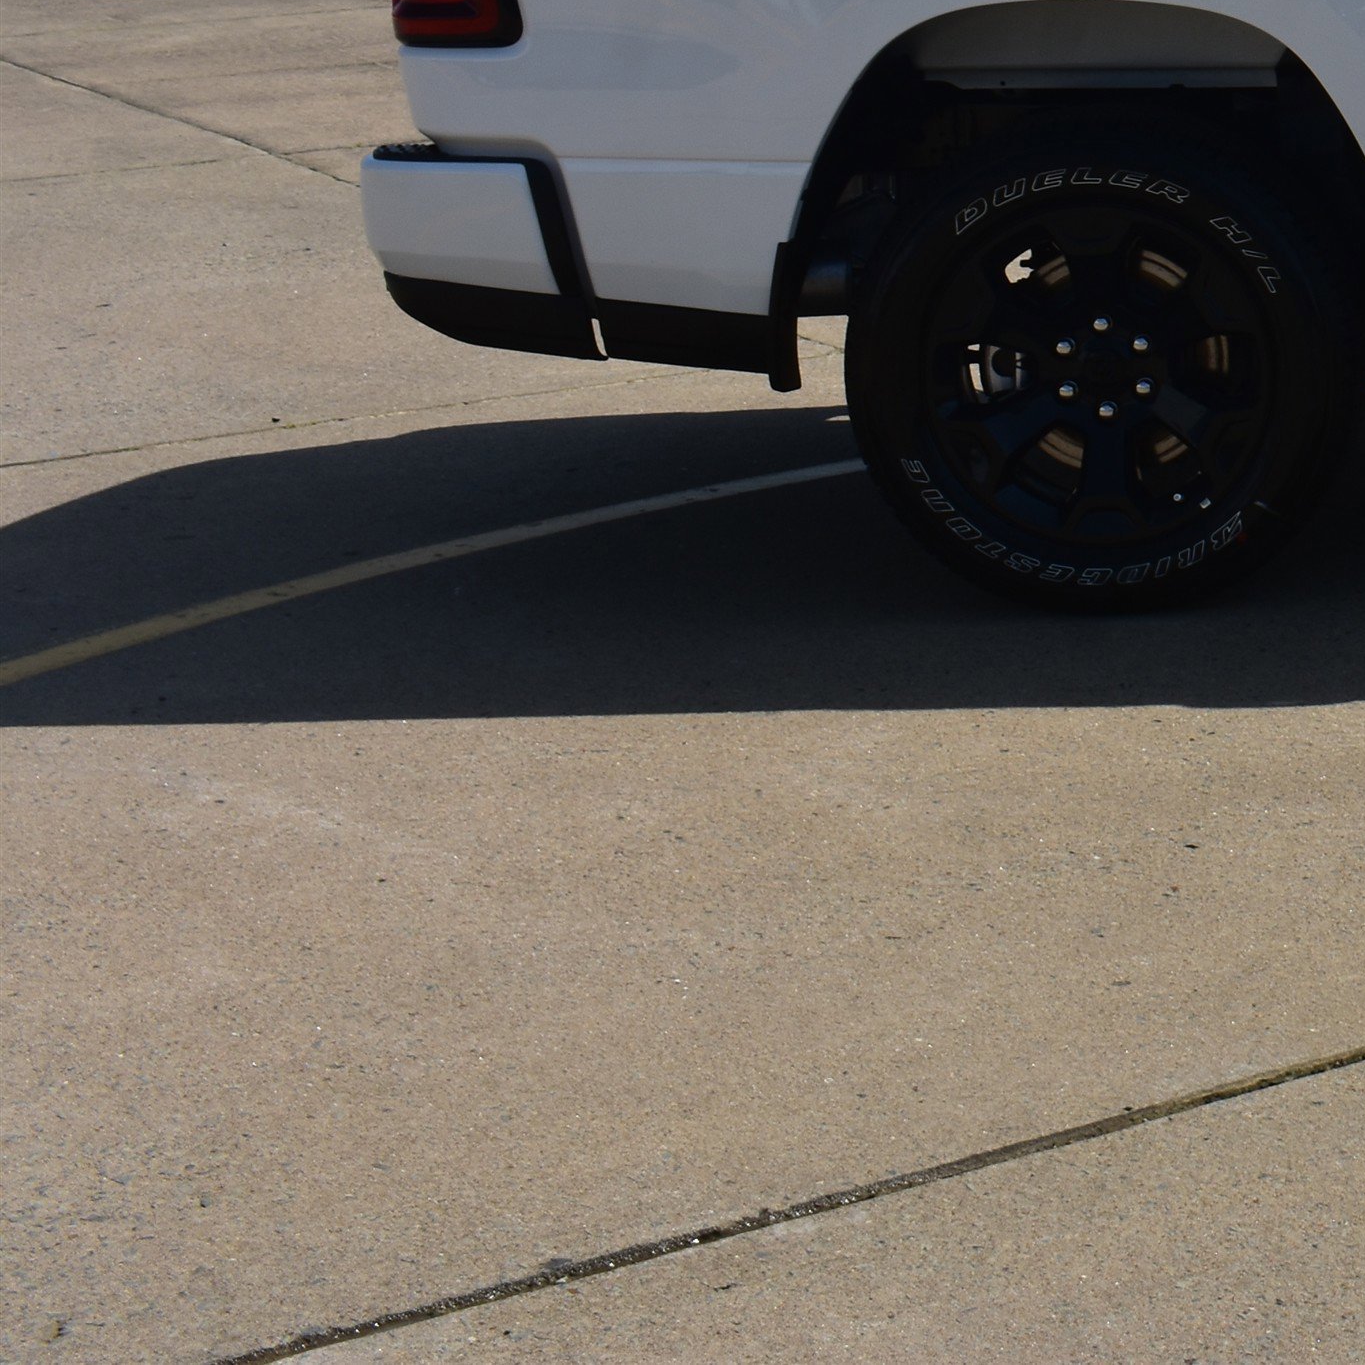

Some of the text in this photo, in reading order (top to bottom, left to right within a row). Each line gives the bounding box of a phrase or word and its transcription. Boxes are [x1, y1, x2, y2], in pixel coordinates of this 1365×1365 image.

[954, 167, 1282, 294] DUELER H/L
[901, 458, 1244, 586] BRIDGESTONE
